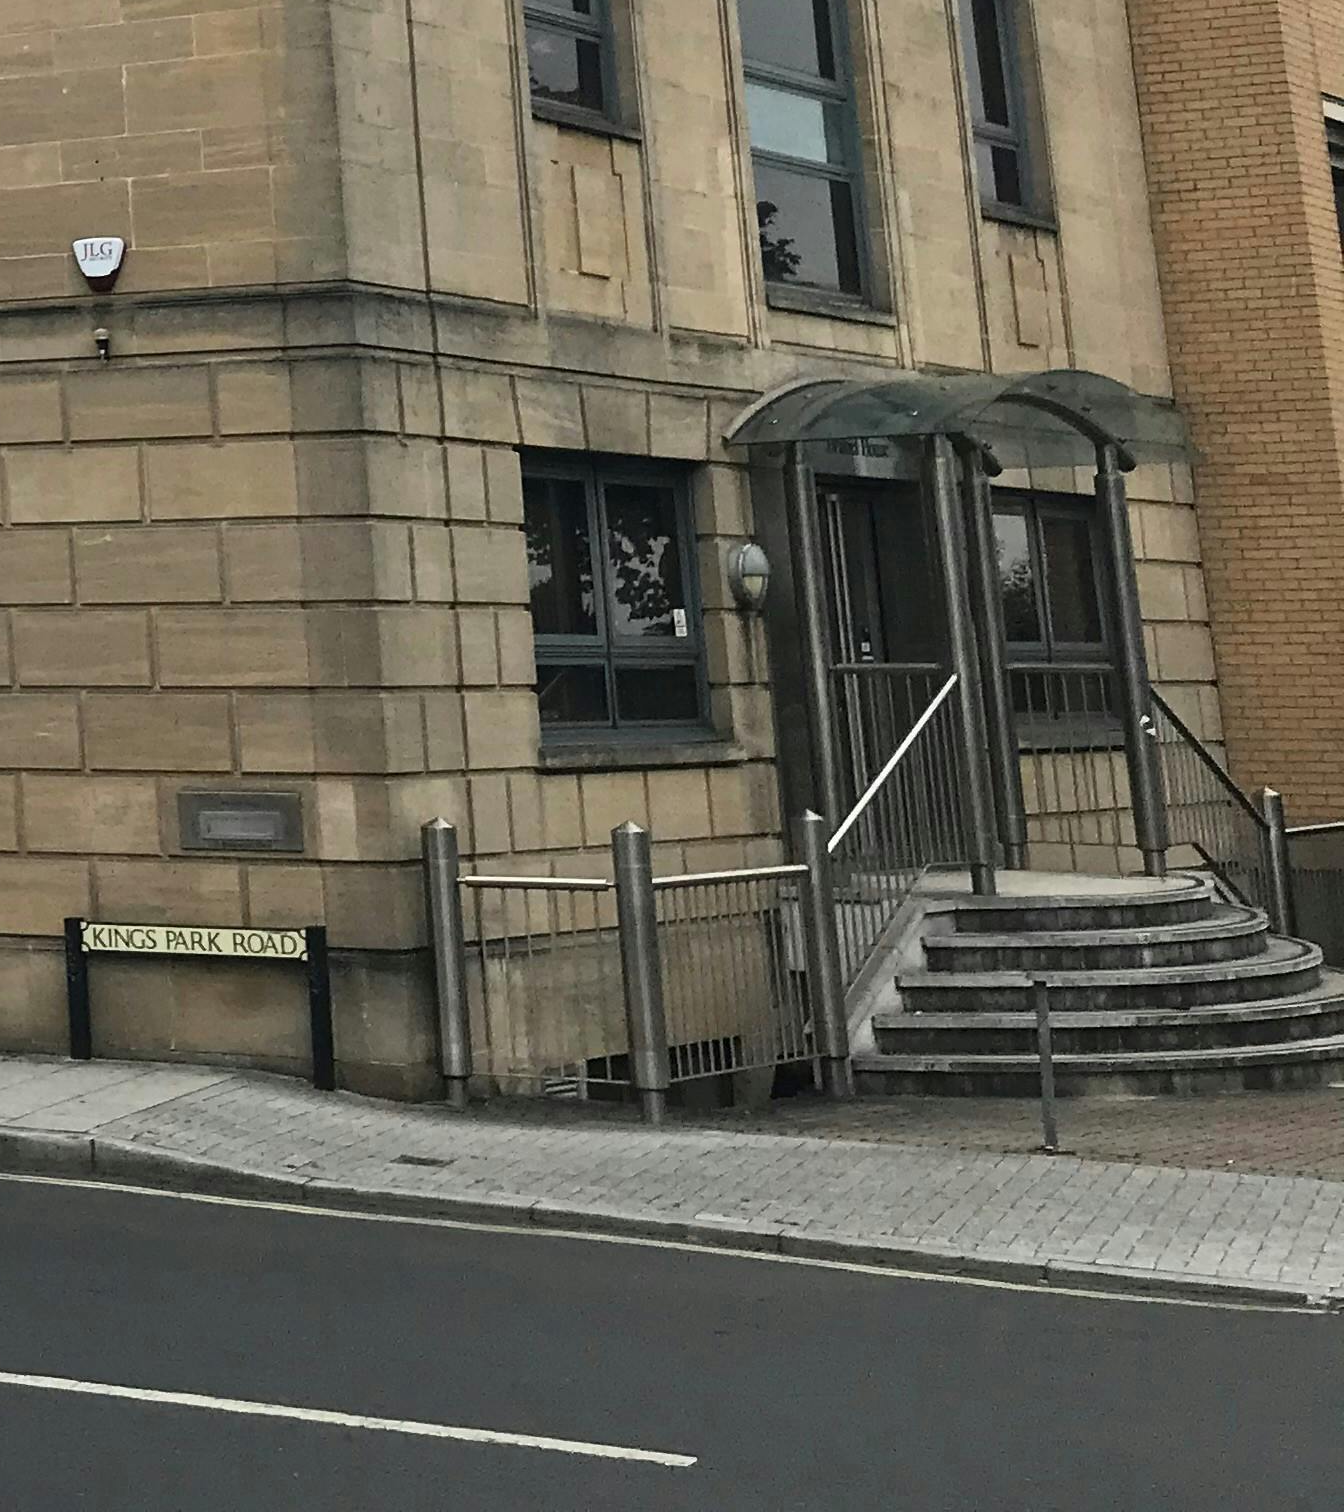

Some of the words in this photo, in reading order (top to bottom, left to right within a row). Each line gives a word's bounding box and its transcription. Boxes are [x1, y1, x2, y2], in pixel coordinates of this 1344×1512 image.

[80, 241, 113, 262] JLG
[92, 927, 158, 950] KINGS
[165, 929, 223, 953] PARK
[232, 932, 298, 955] ROAD
